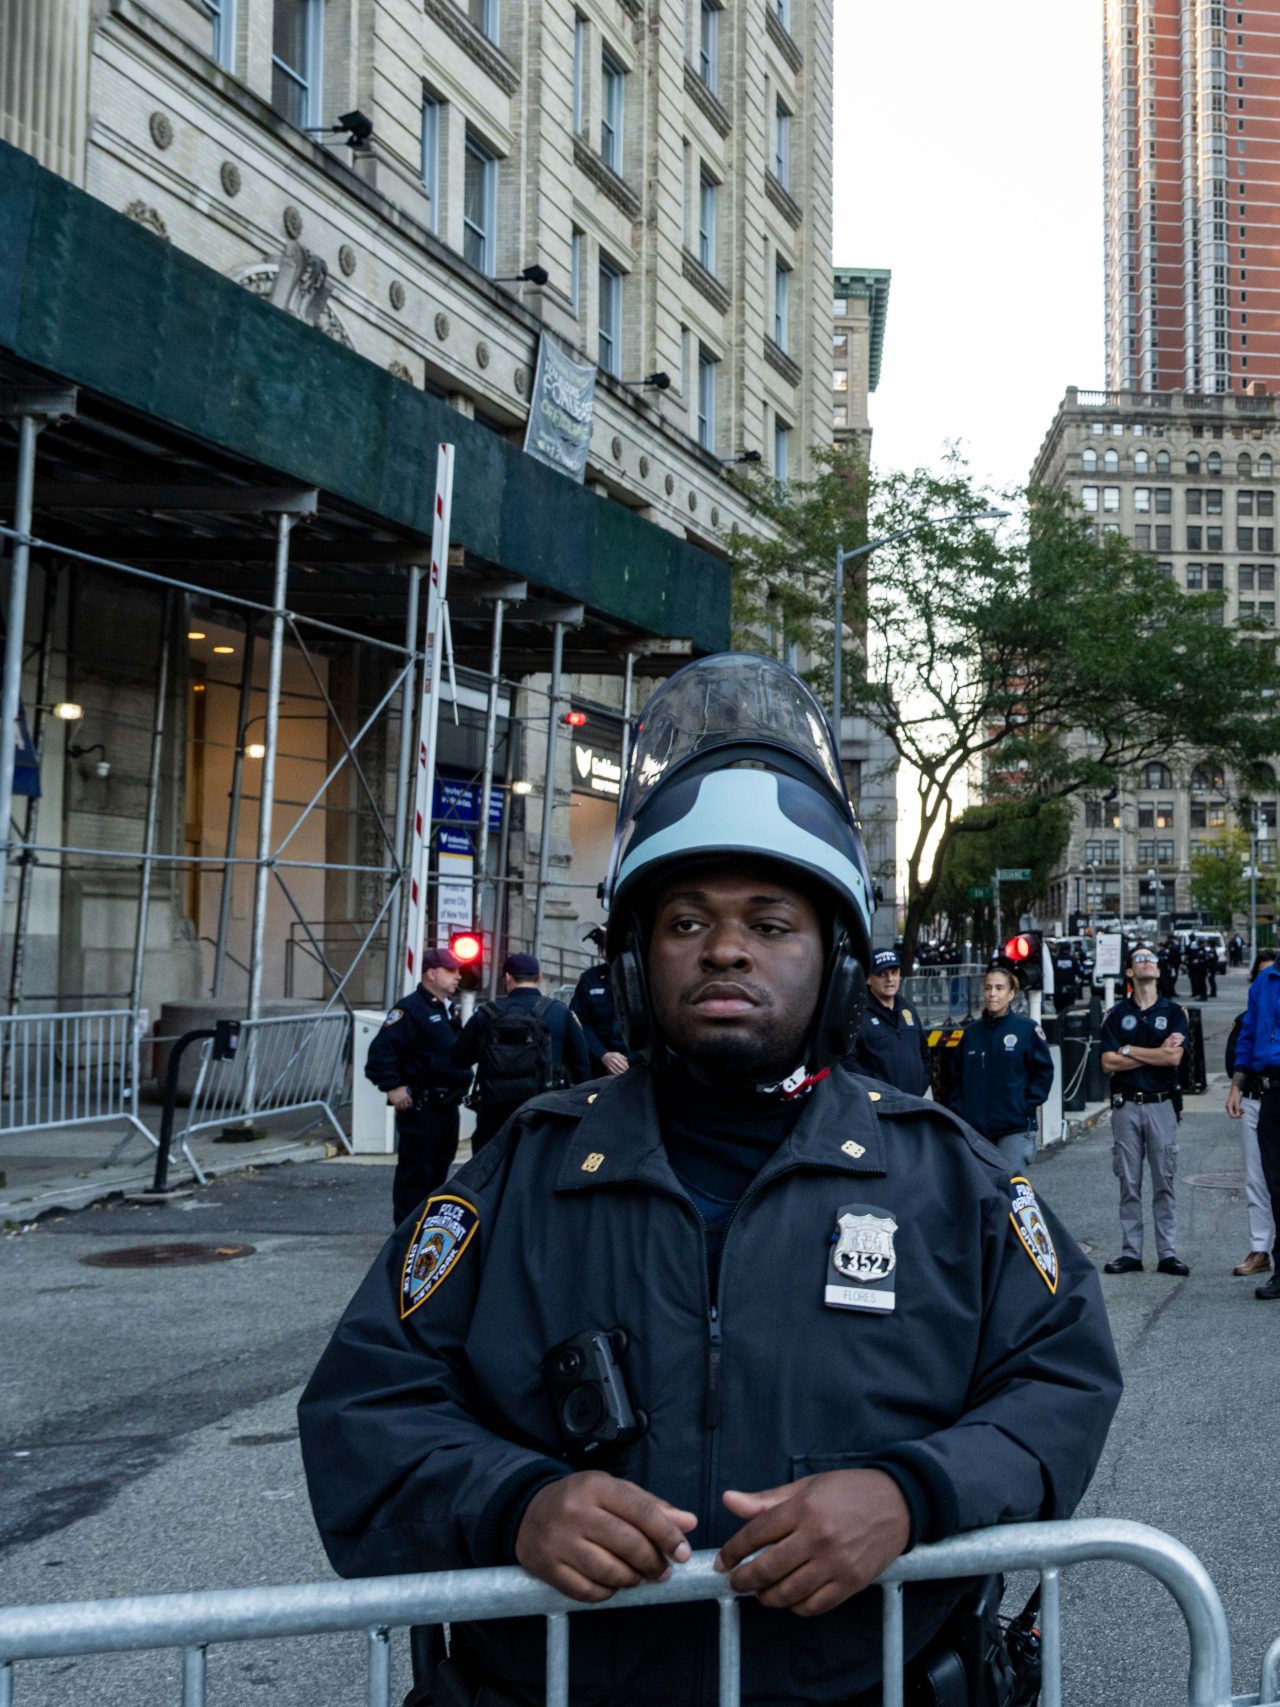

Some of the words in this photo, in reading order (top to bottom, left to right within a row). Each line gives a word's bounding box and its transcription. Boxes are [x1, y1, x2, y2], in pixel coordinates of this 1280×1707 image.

[438, 1203, 465, 1221] POLICE
[423, 1215, 467, 1241] DEPARTMENT
[847, 1251, 883, 1274] 352
[413, 1281, 432, 1304] NEW
[432, 1248, 458, 1281] YORK
[843, 1289, 877, 1303] FLORES
